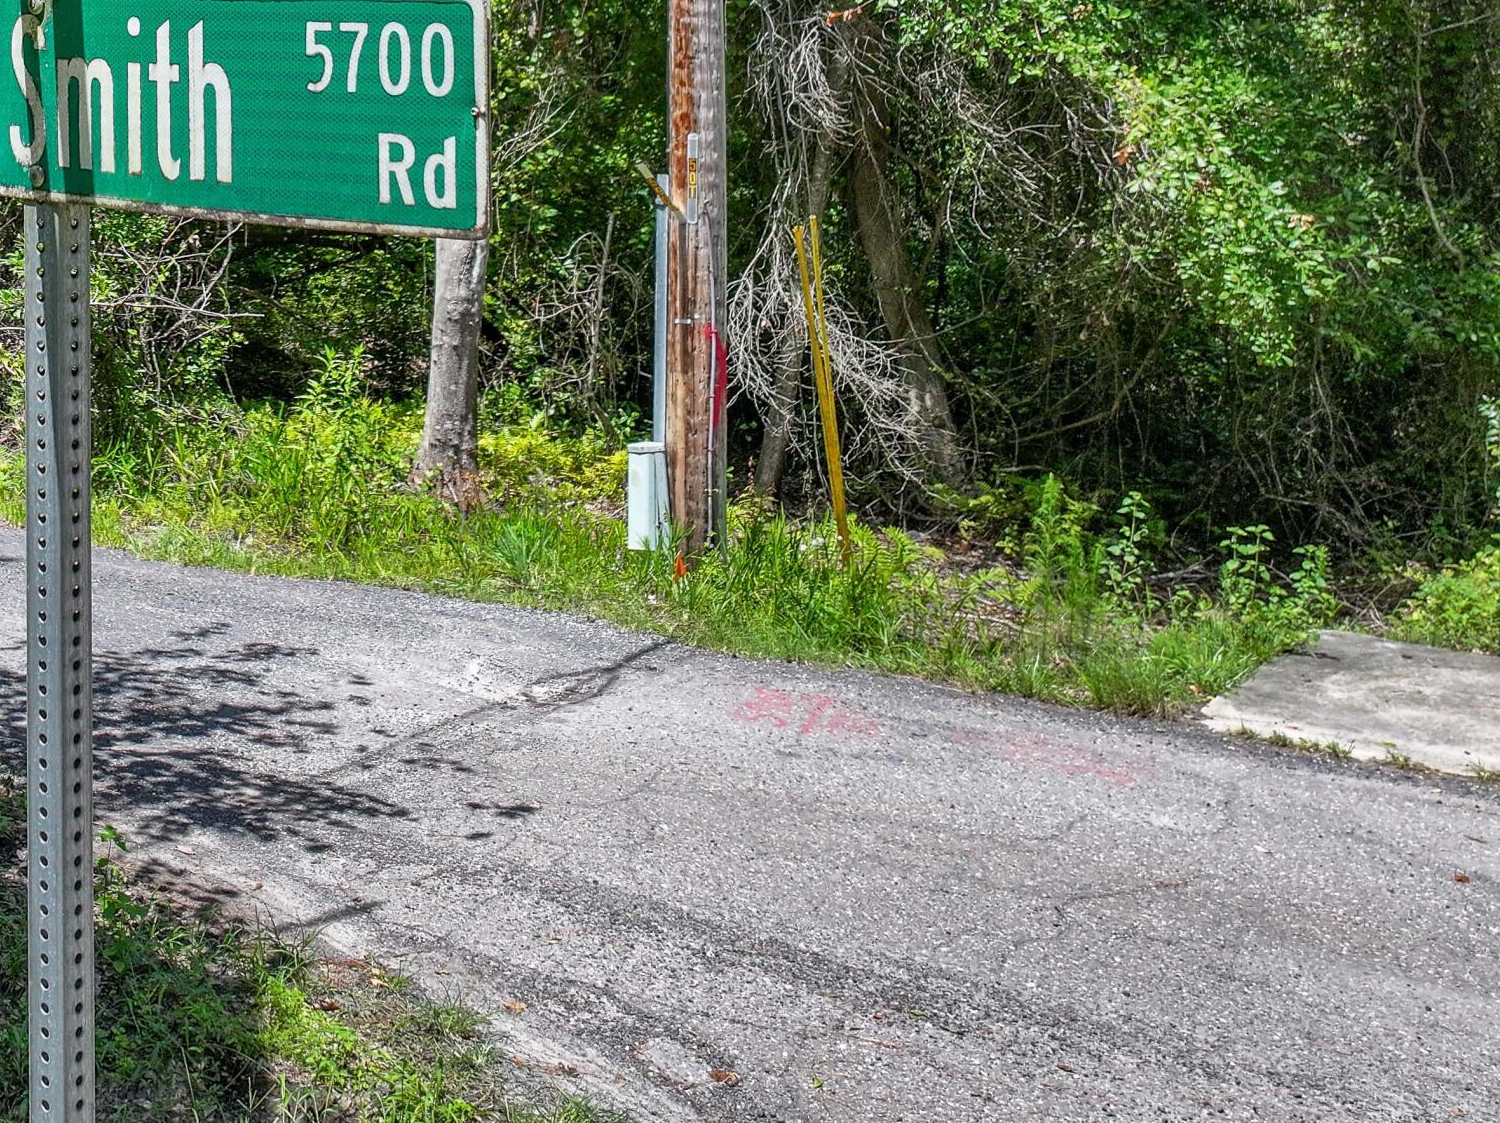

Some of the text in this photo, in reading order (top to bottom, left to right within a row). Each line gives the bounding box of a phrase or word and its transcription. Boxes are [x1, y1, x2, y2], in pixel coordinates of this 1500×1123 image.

[305, 21, 454, 97] 5700
[9, 14, 233, 183] Smith
[378, 132, 457, 209] Rd
